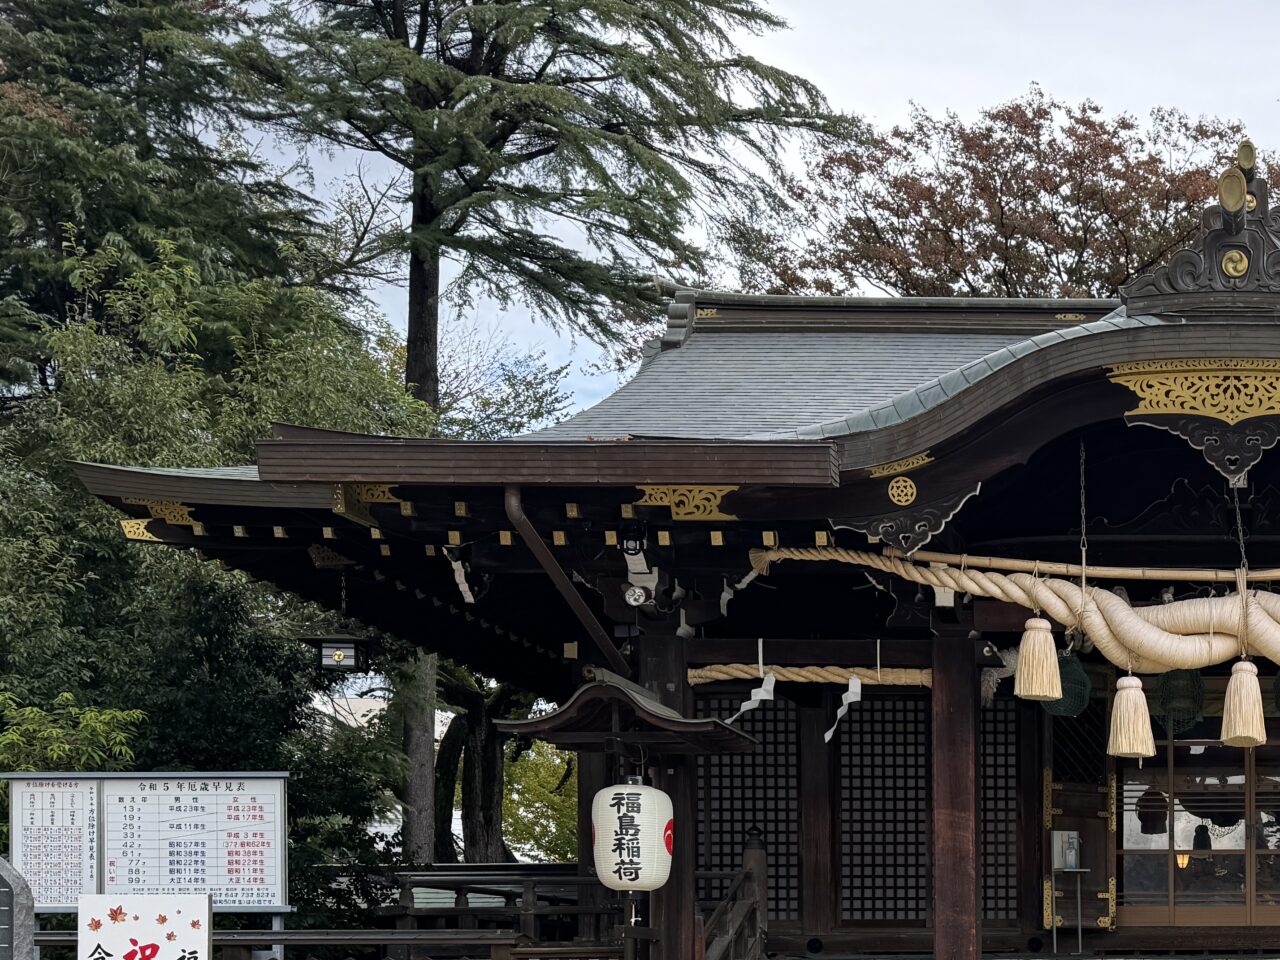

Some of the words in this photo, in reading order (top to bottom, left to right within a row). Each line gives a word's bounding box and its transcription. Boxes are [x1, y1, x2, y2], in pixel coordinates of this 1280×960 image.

[138, 782, 246, 791] 令和5年厄歳早見表
[169, 805, 206, 813] 平成23年生
[227, 805, 264, 813] 平成23年生
[609, 792, 643, 882] 福島稲荷
[108, 860, 116, 883] 祝い年
